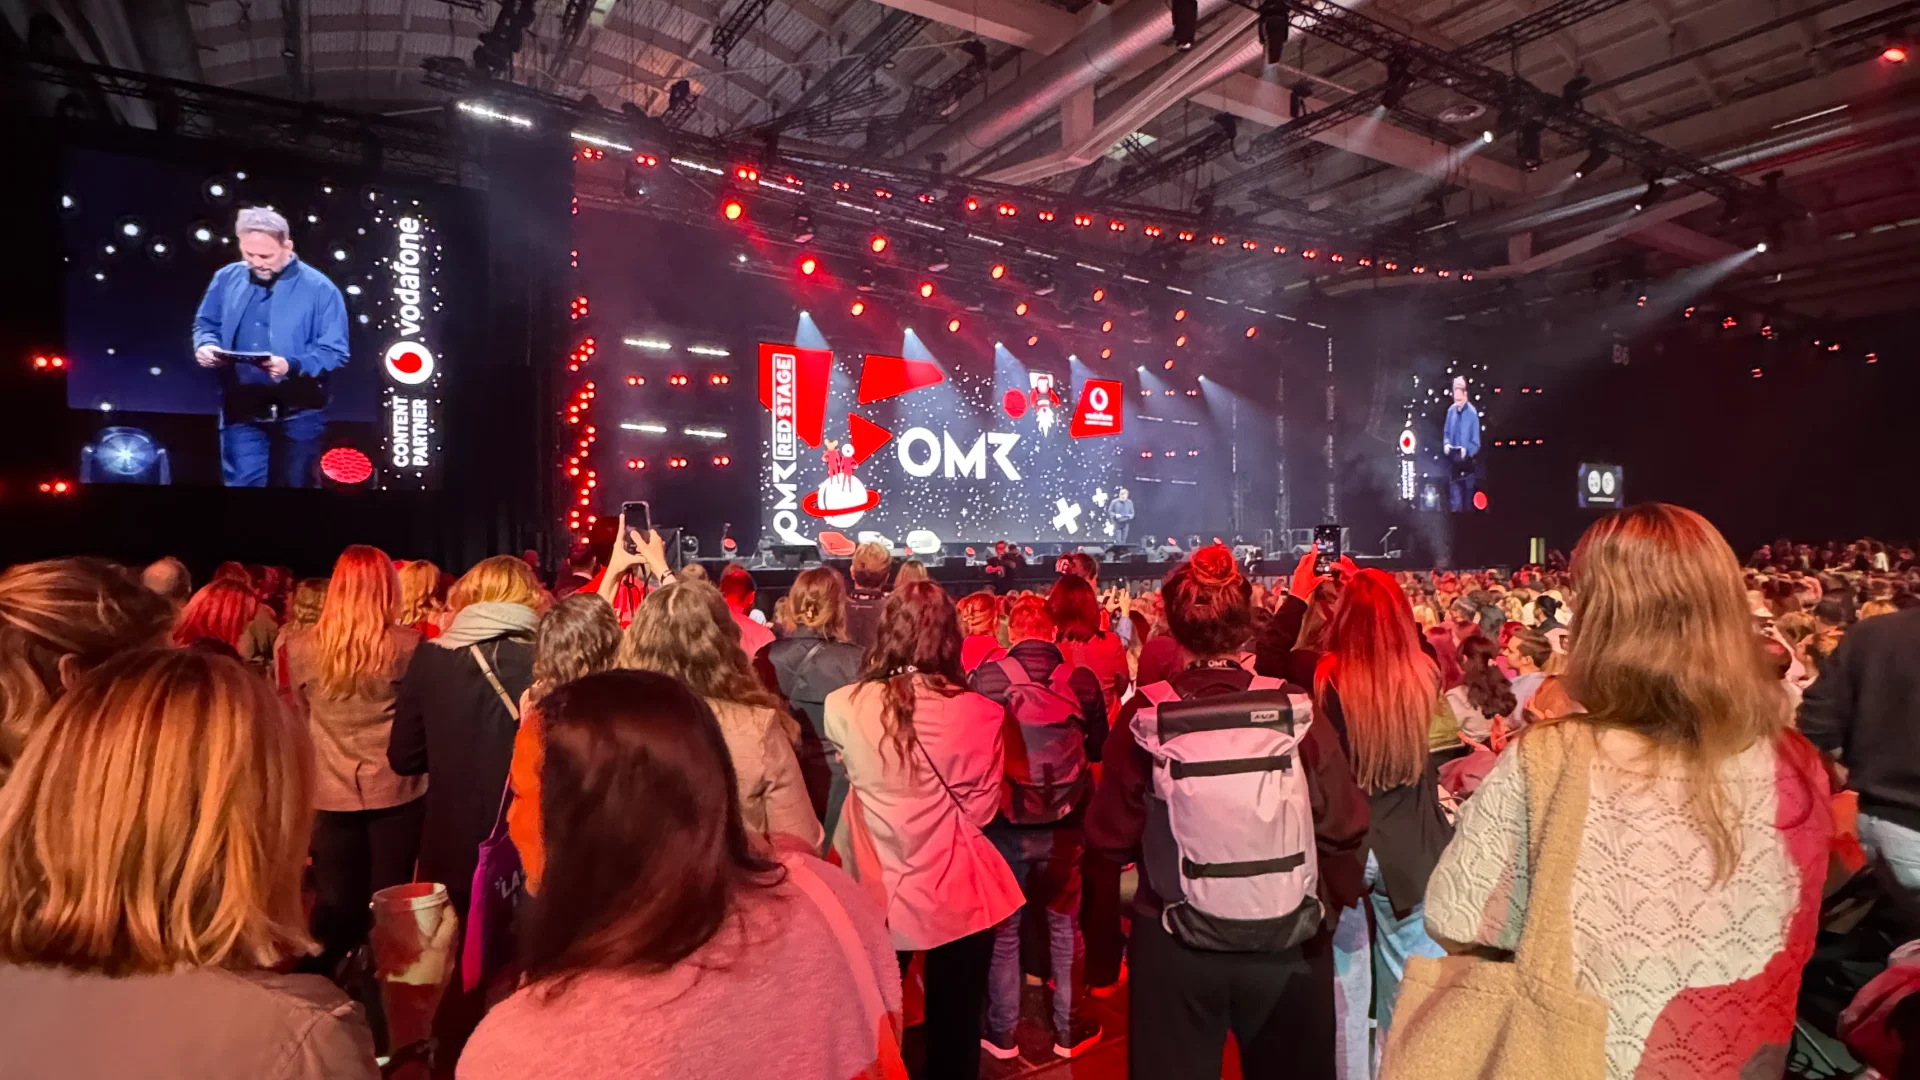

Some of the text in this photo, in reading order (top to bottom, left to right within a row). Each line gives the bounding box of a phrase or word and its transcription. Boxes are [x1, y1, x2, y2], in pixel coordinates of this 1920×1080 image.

[393, 217, 421, 336] vodafone
[393, 396, 409, 468] CONTENT
[413, 398, 428, 467] PARTNER
[773, 358, 800, 545] OMR RED STAGE
[898, 427, 1022, 481] OMR
